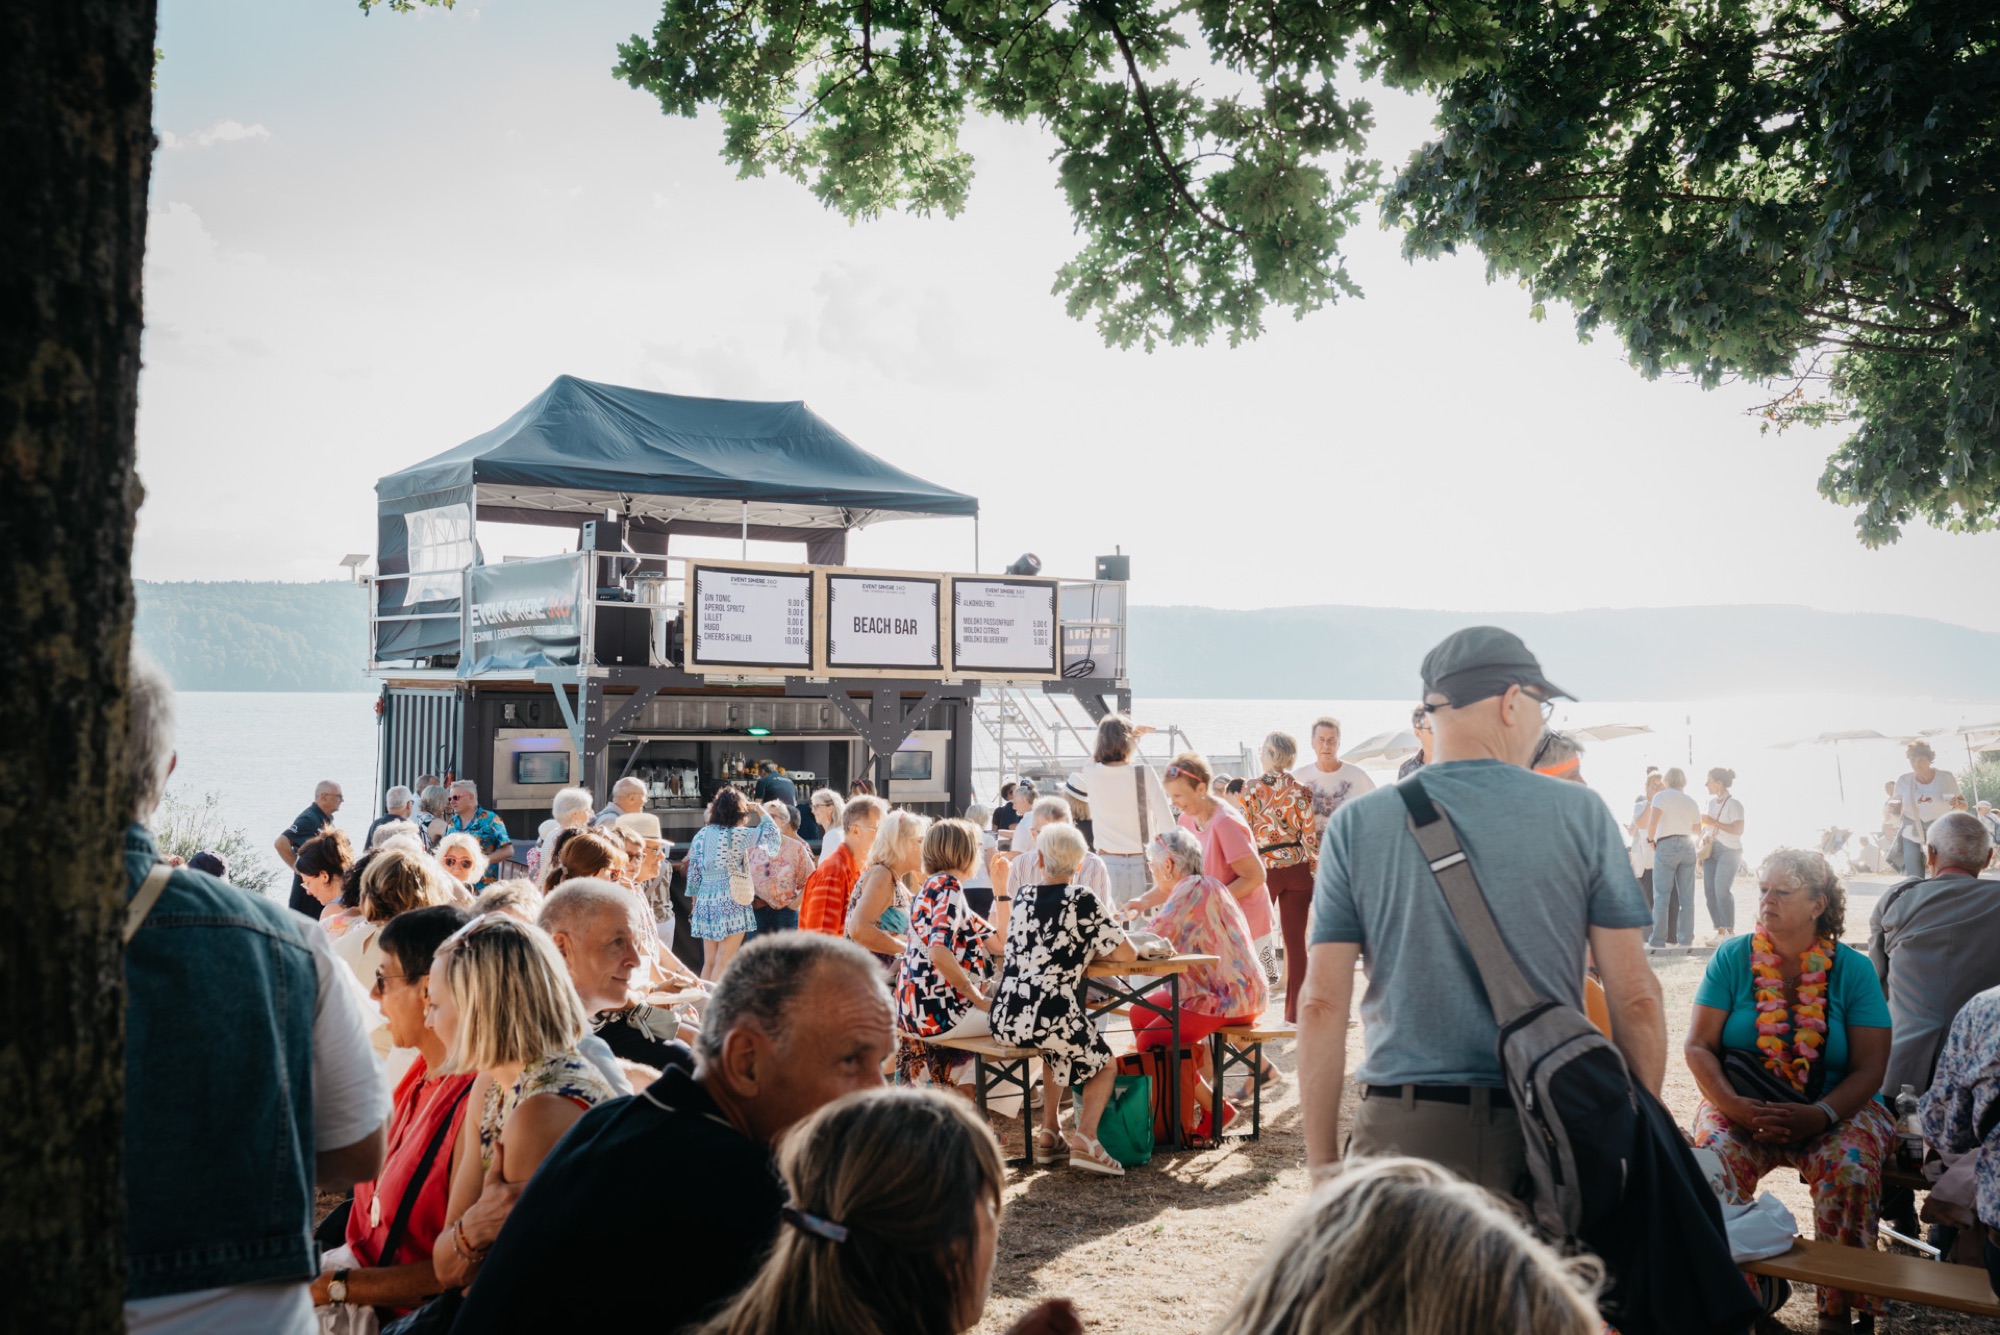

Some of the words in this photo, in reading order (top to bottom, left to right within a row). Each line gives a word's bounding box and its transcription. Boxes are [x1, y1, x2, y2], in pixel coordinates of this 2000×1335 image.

[704, 593, 714, 601] GIN
[715, 594, 731, 602] TONIC
[704, 603, 725, 611] APEROL
[726, 604, 745, 612] SPRITZ
[471, 601, 507, 627] EVENT
[704, 613, 722, 621] LILLET
[703, 623, 719, 631] HUGO
[853, 616, 891, 634] BEACH
[895, 618, 918, 635] BAR
[983, 627, 999, 635] CITRUS
[703, 632, 725, 641] CHEERS
[726, 633, 730, 641] &
[731, 633, 752, 642] CHILLER
